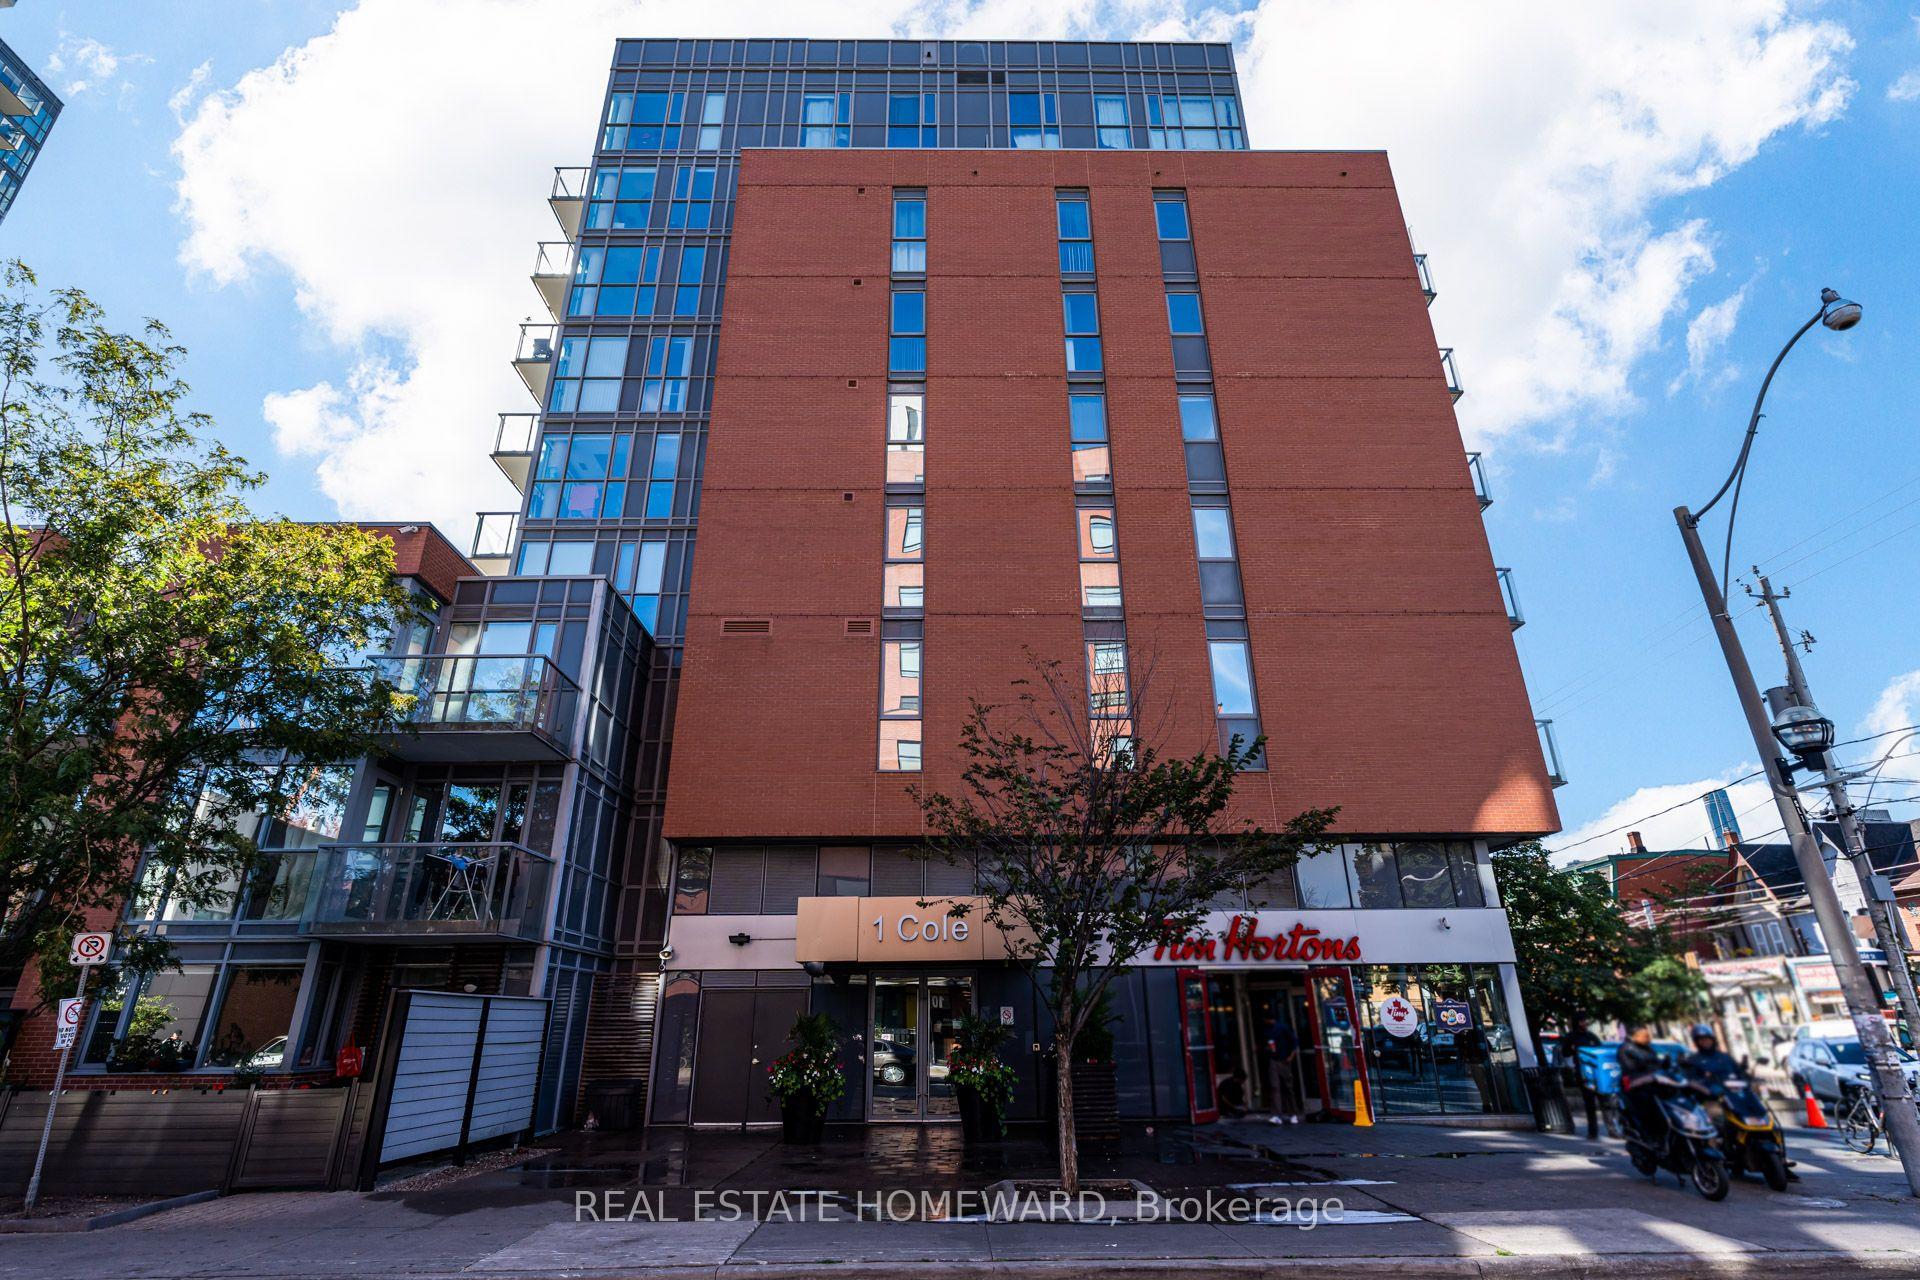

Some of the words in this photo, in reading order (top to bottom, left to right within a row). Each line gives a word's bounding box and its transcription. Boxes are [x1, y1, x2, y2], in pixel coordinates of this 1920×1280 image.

[873, 914, 883, 942] 1
[897, 914, 969, 942] Cole
[1223, 915, 1362, 961] Hortons
